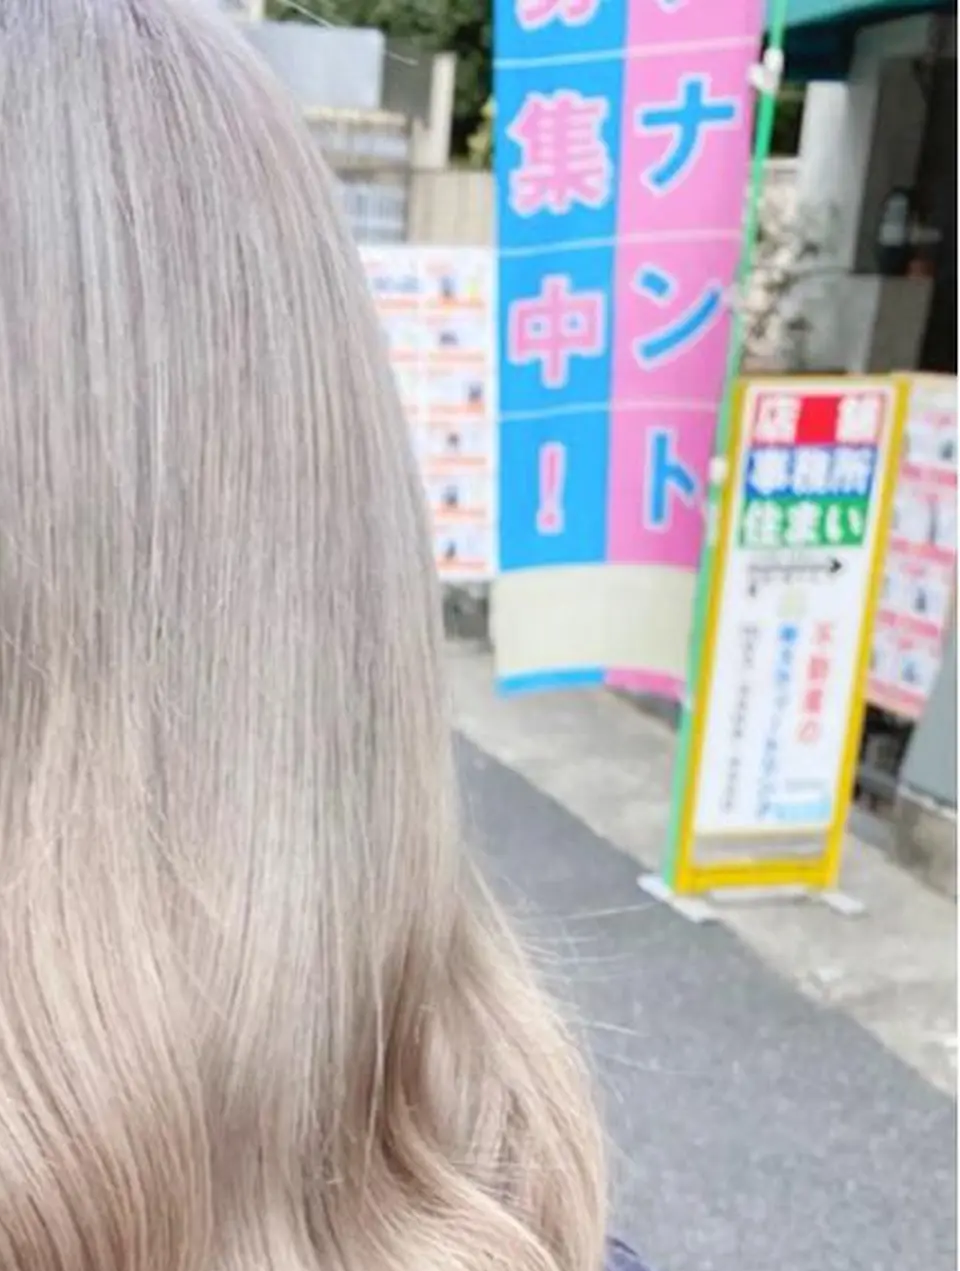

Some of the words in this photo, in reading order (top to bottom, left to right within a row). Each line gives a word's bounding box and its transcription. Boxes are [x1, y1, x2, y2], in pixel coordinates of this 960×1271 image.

[506, 0, 610, 533] 集中！
[634, 0, 736, 531] ナント
[743, 500, 864, 545] 住まい
